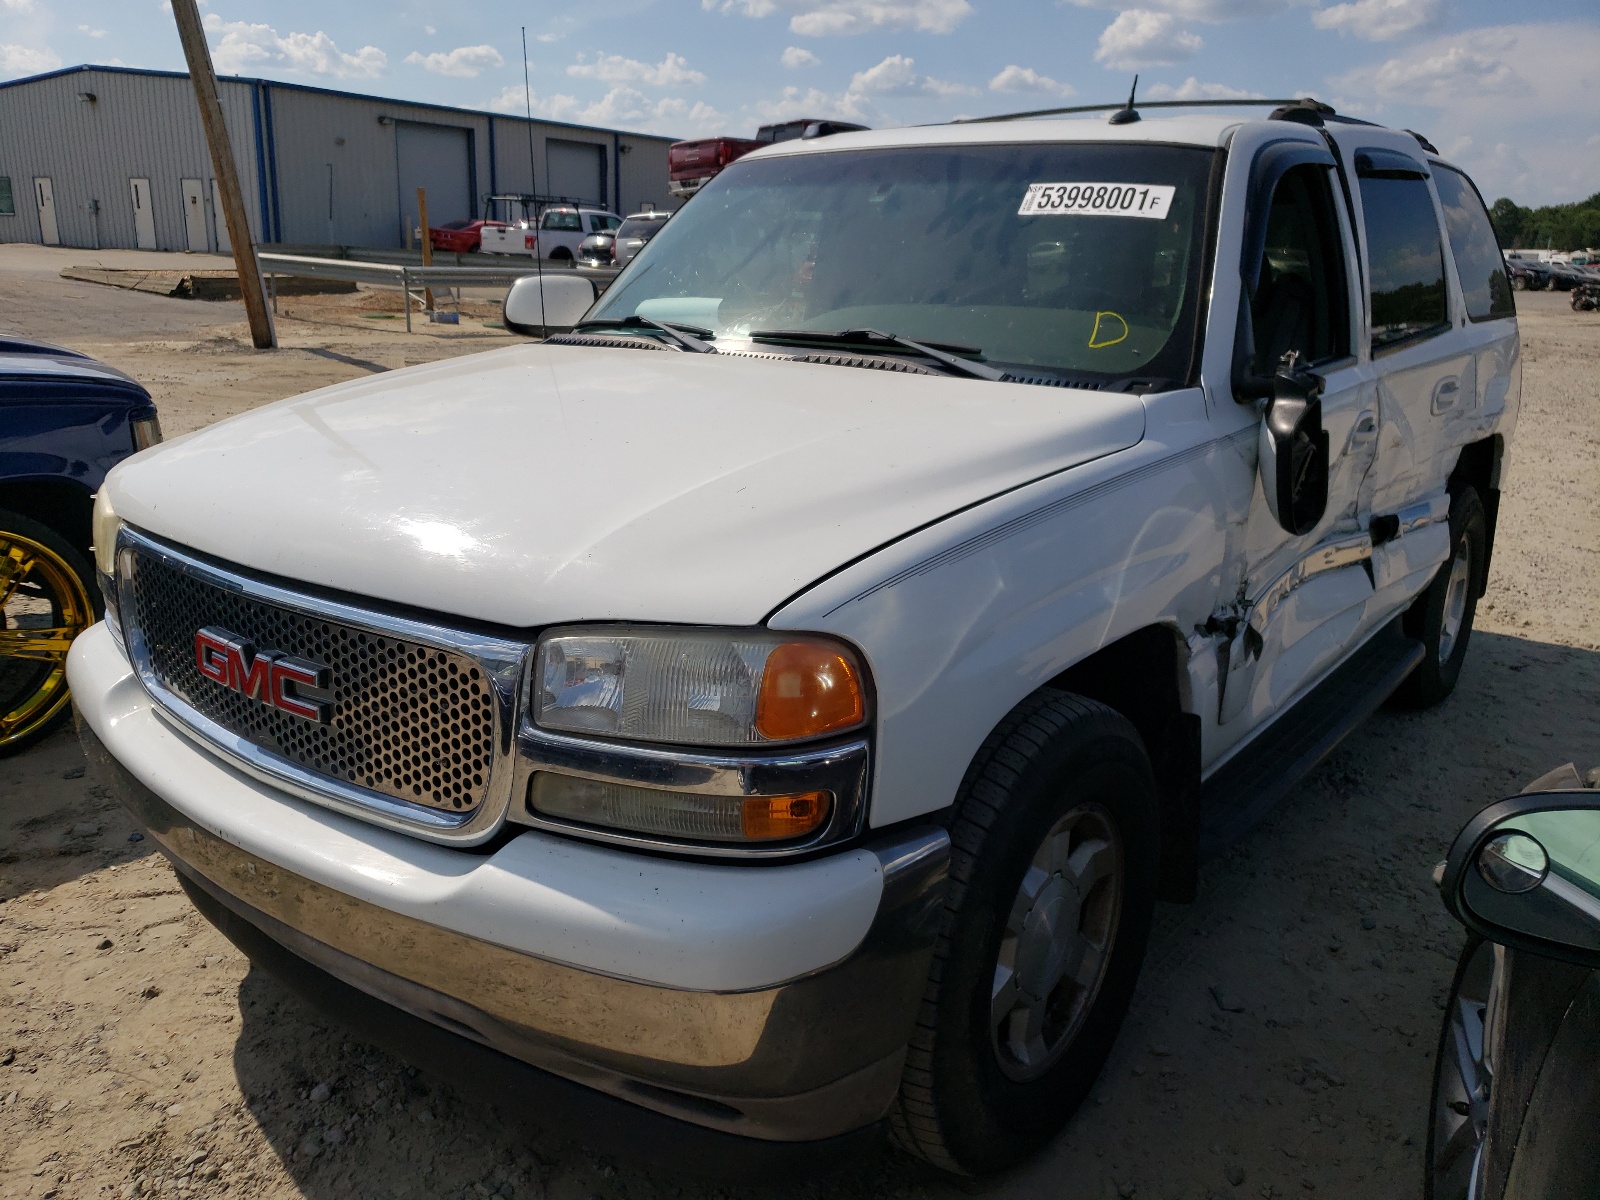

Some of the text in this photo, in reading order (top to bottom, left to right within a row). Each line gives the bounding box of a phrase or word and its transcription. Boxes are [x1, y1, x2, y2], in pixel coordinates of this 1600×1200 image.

[1037, 186, 1149, 210] 53998001
[1149, 197, 1161, 209] F
[1088, 311, 1128, 348] D
[195, 628, 322, 723] GMC
